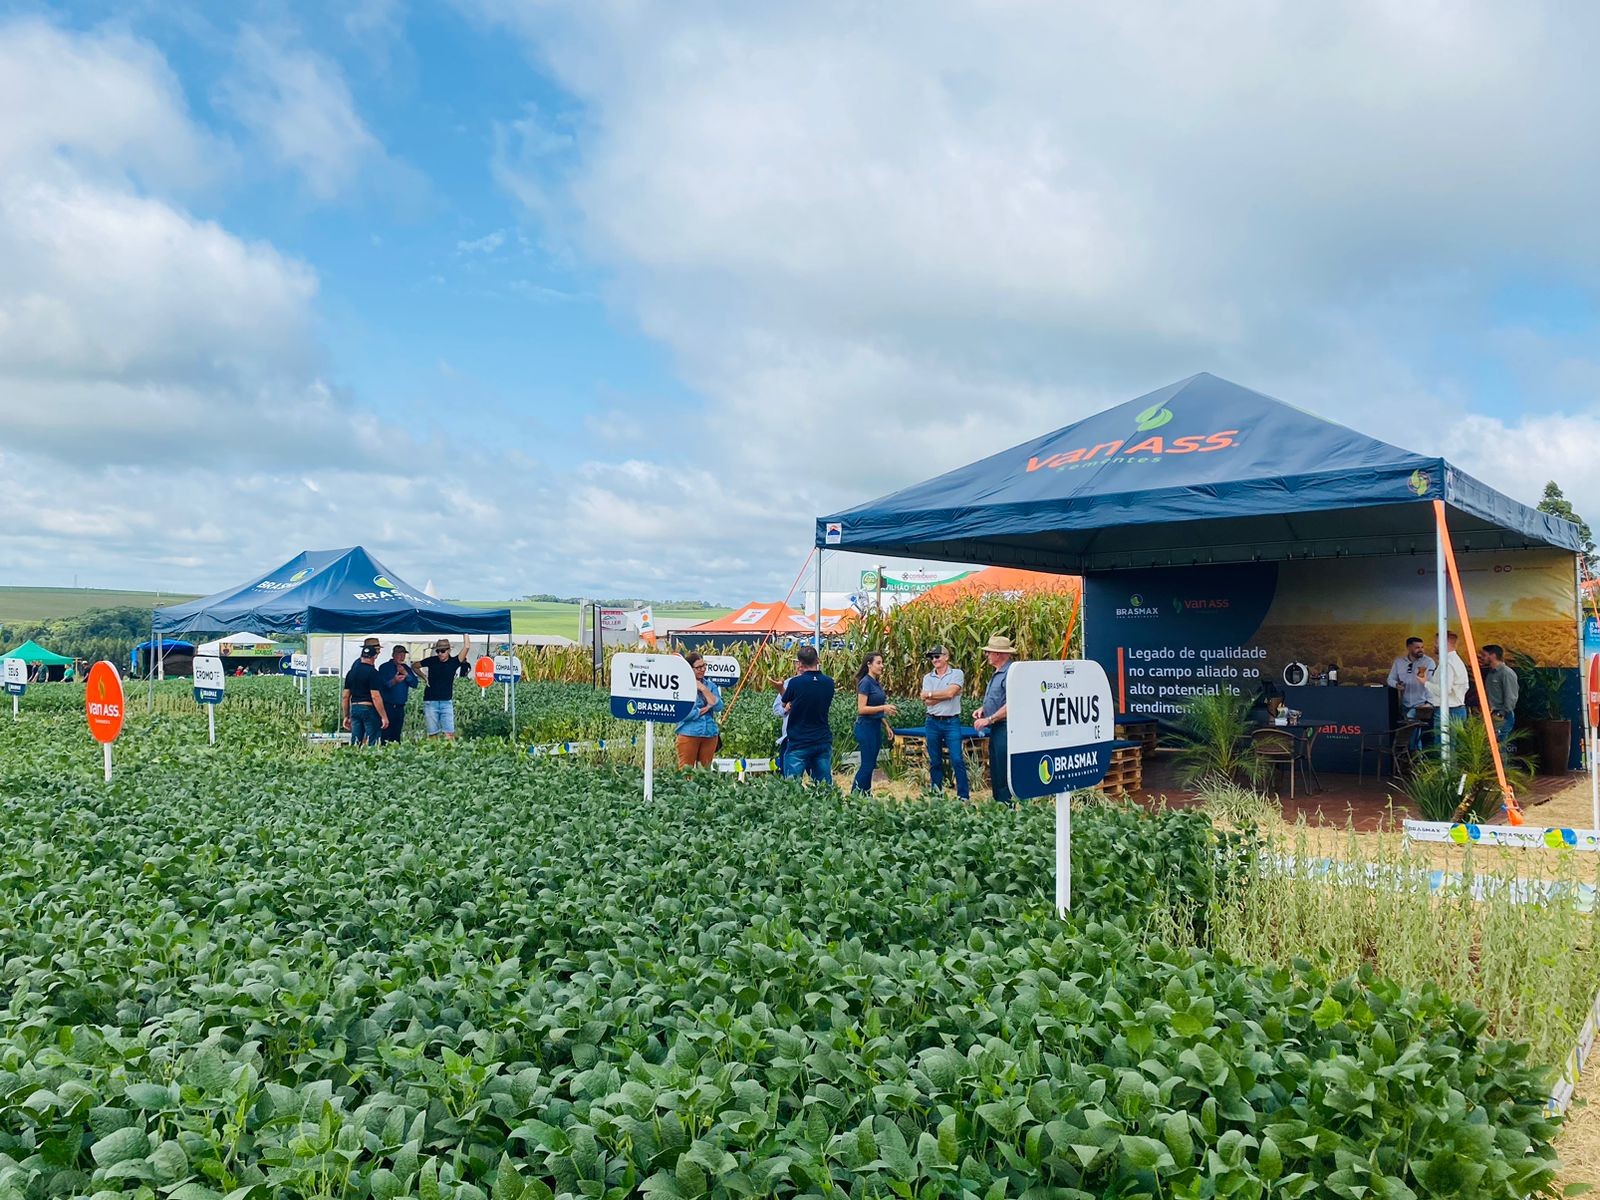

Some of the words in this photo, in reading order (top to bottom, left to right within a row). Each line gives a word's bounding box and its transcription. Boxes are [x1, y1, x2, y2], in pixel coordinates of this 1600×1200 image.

[1025, 439, 1124, 473] van
[1056, 456, 1162, 473] sementes
[1184, 599, 1207, 609] van
[1116, 607, 1159, 616] BRASMAX
[1128, 647, 1176, 662] Legado
[1179, 647, 1196, 659] de
[1199, 646, 1268, 662] qualidade
[195, 670, 213, 681] CROMO
[629, 670, 680, 690] VÊNUS
[1129, 667, 1145, 677] no
[1149, 667, 1193, 680] campo
[1196, 666, 1239, 678] aliado
[1242, 667, 1260, 678] ao
[1047, 682, 1068, 690] BRASMAX
[1129, 683, 1155, 696] alto
[1159, 684, 1220, 698] potencial
[673, 691, 680, 700] CE
[88, 702, 103, 716] van
[637, 702, 676, 713] BRASMAX
[1041, 692, 1100, 727] VÊNUS
[1130, 702, 1197, 715] rendimen
[1094, 725, 1101, 740] CE
[1340, 725, 1361, 735] ASS
[1054, 751, 1098, 772] BRASMAX
[1407, 826, 1441, 834] BRASMAX
